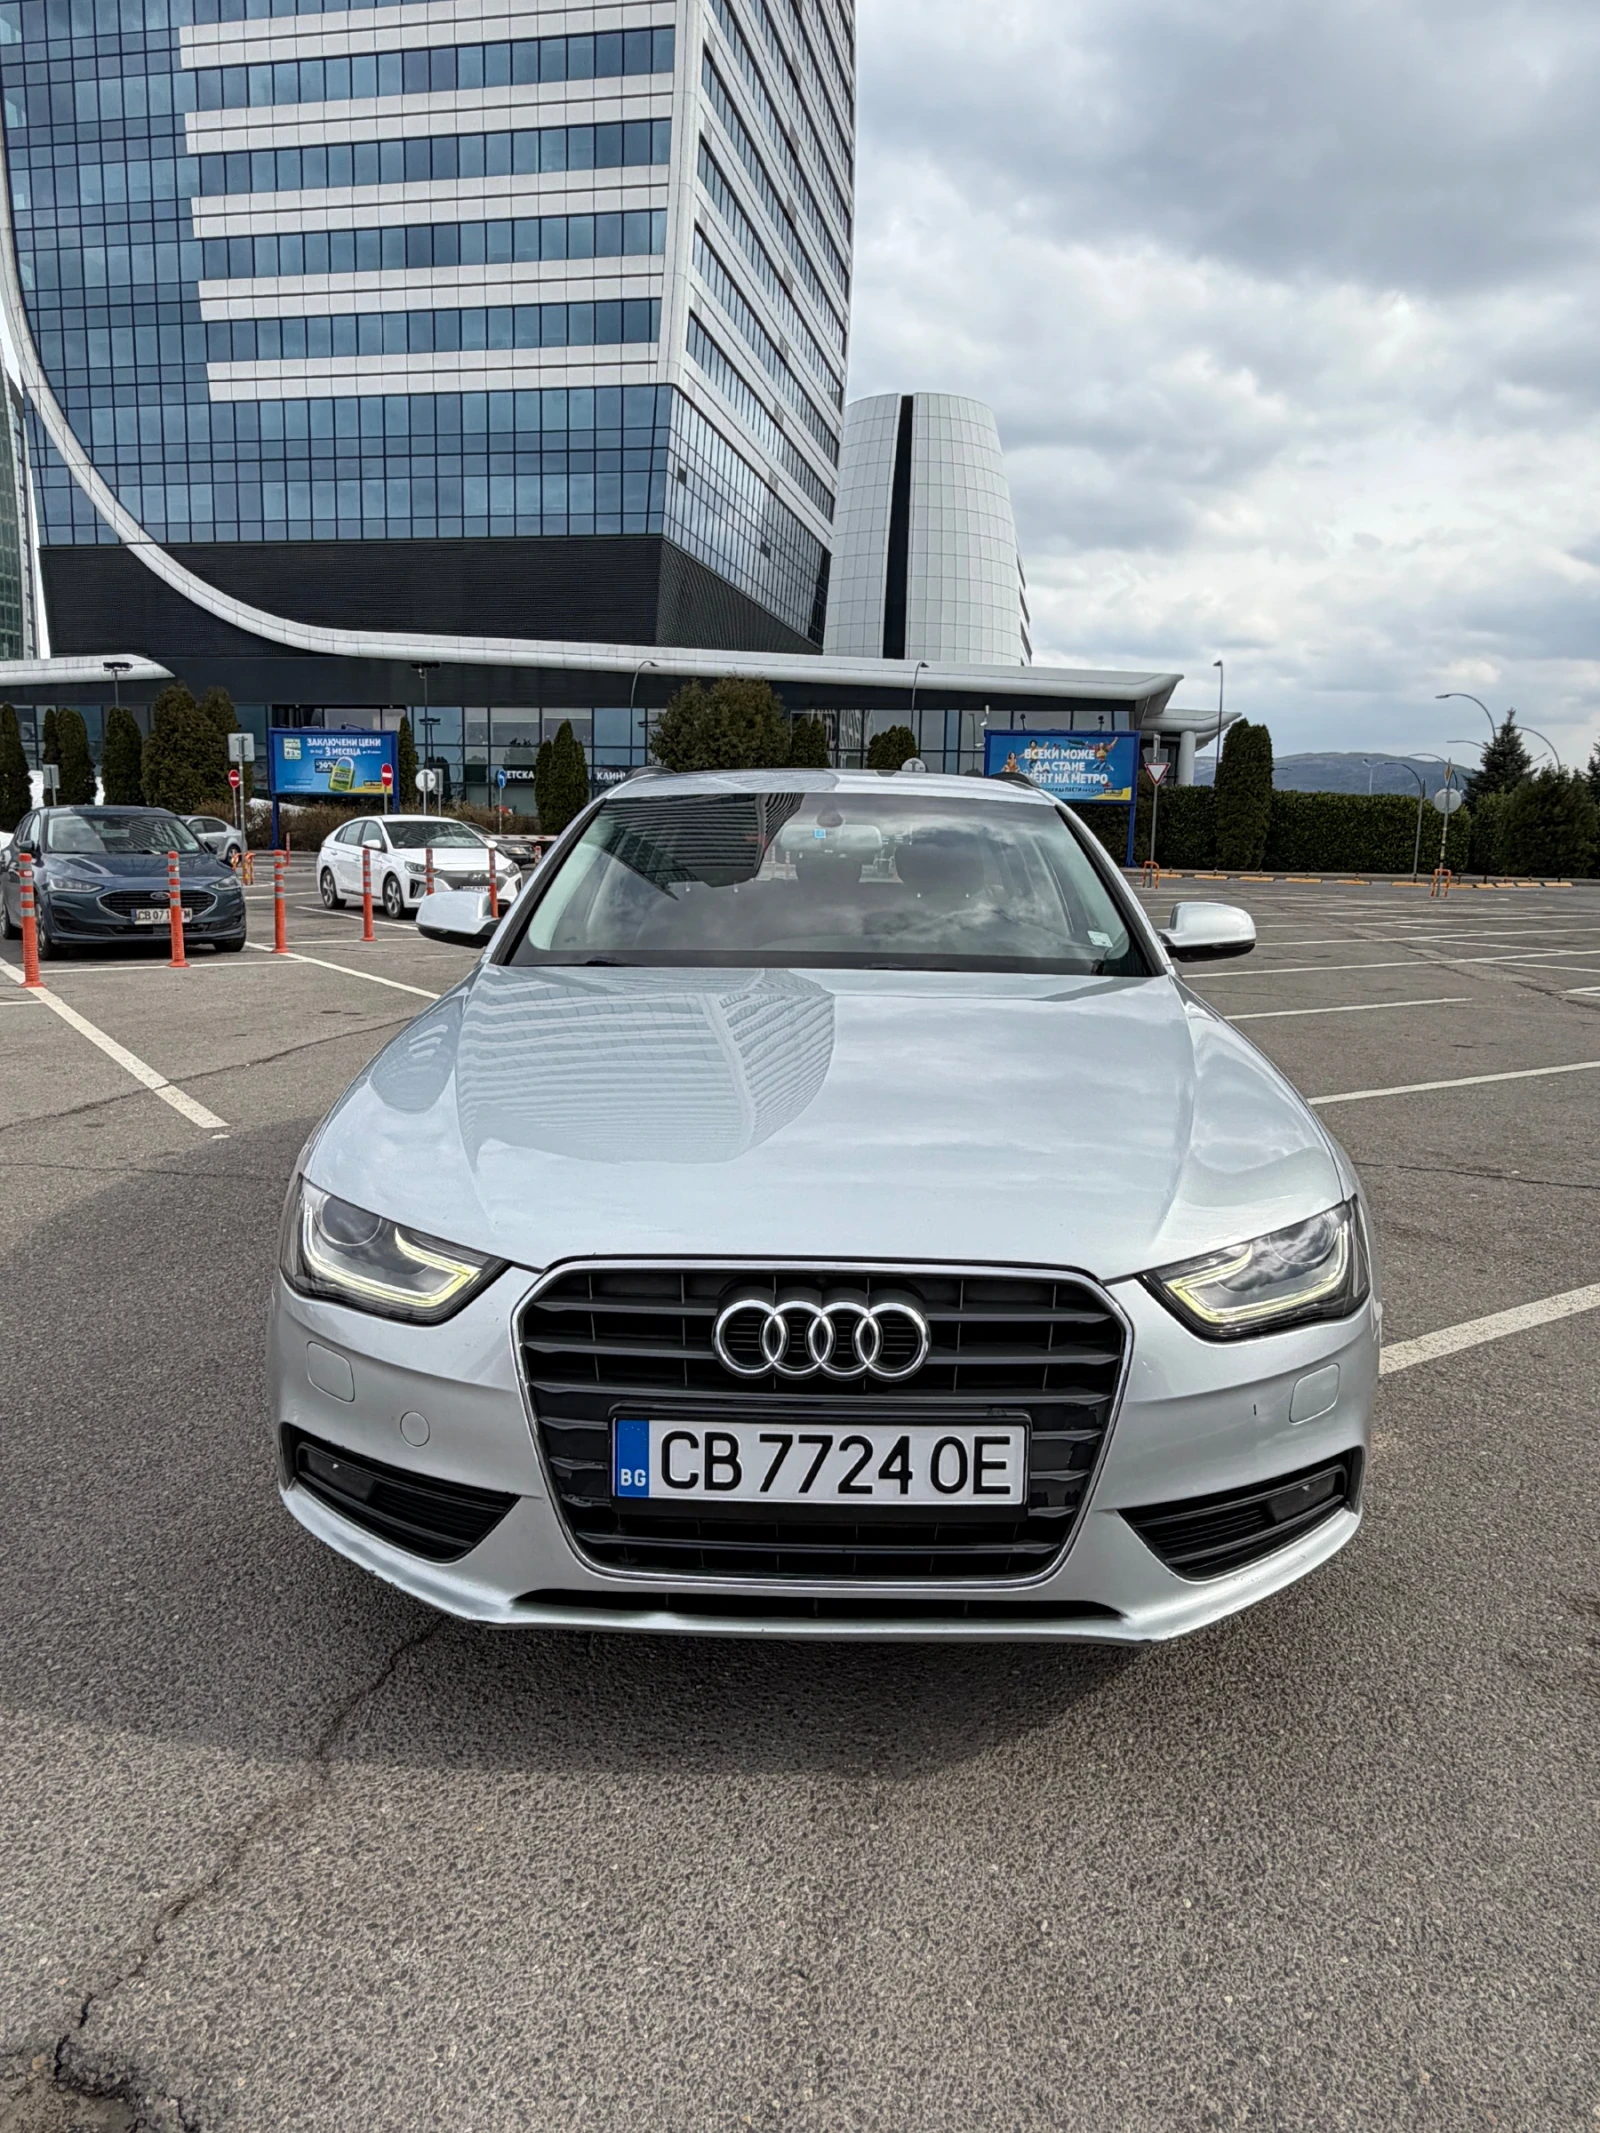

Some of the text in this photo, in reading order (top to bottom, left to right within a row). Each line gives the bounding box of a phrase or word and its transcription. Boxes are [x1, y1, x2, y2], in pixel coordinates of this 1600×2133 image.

[307, 738, 381, 747] ЗАКЛЮЧЕНИ ЦЕНИ
[325, 747, 331, 756] 3
[332, 748, 361, 756] МЕСЕЦА
[1024, 748, 1095, 760] ВСЕКИ МОЖЕ
[1034, 762, 1085, 772] ДА СТАНЕ
[506, 770, 535, 779] ЕТСКА
[1055, 773, 1070, 784] НА
[1071, 773, 1108, 785] МЕТРО
[660, 1430, 743, 1491] CB
[759, 1433, 914, 1496] 7724
[620, 1469, 647, 1487] BG
